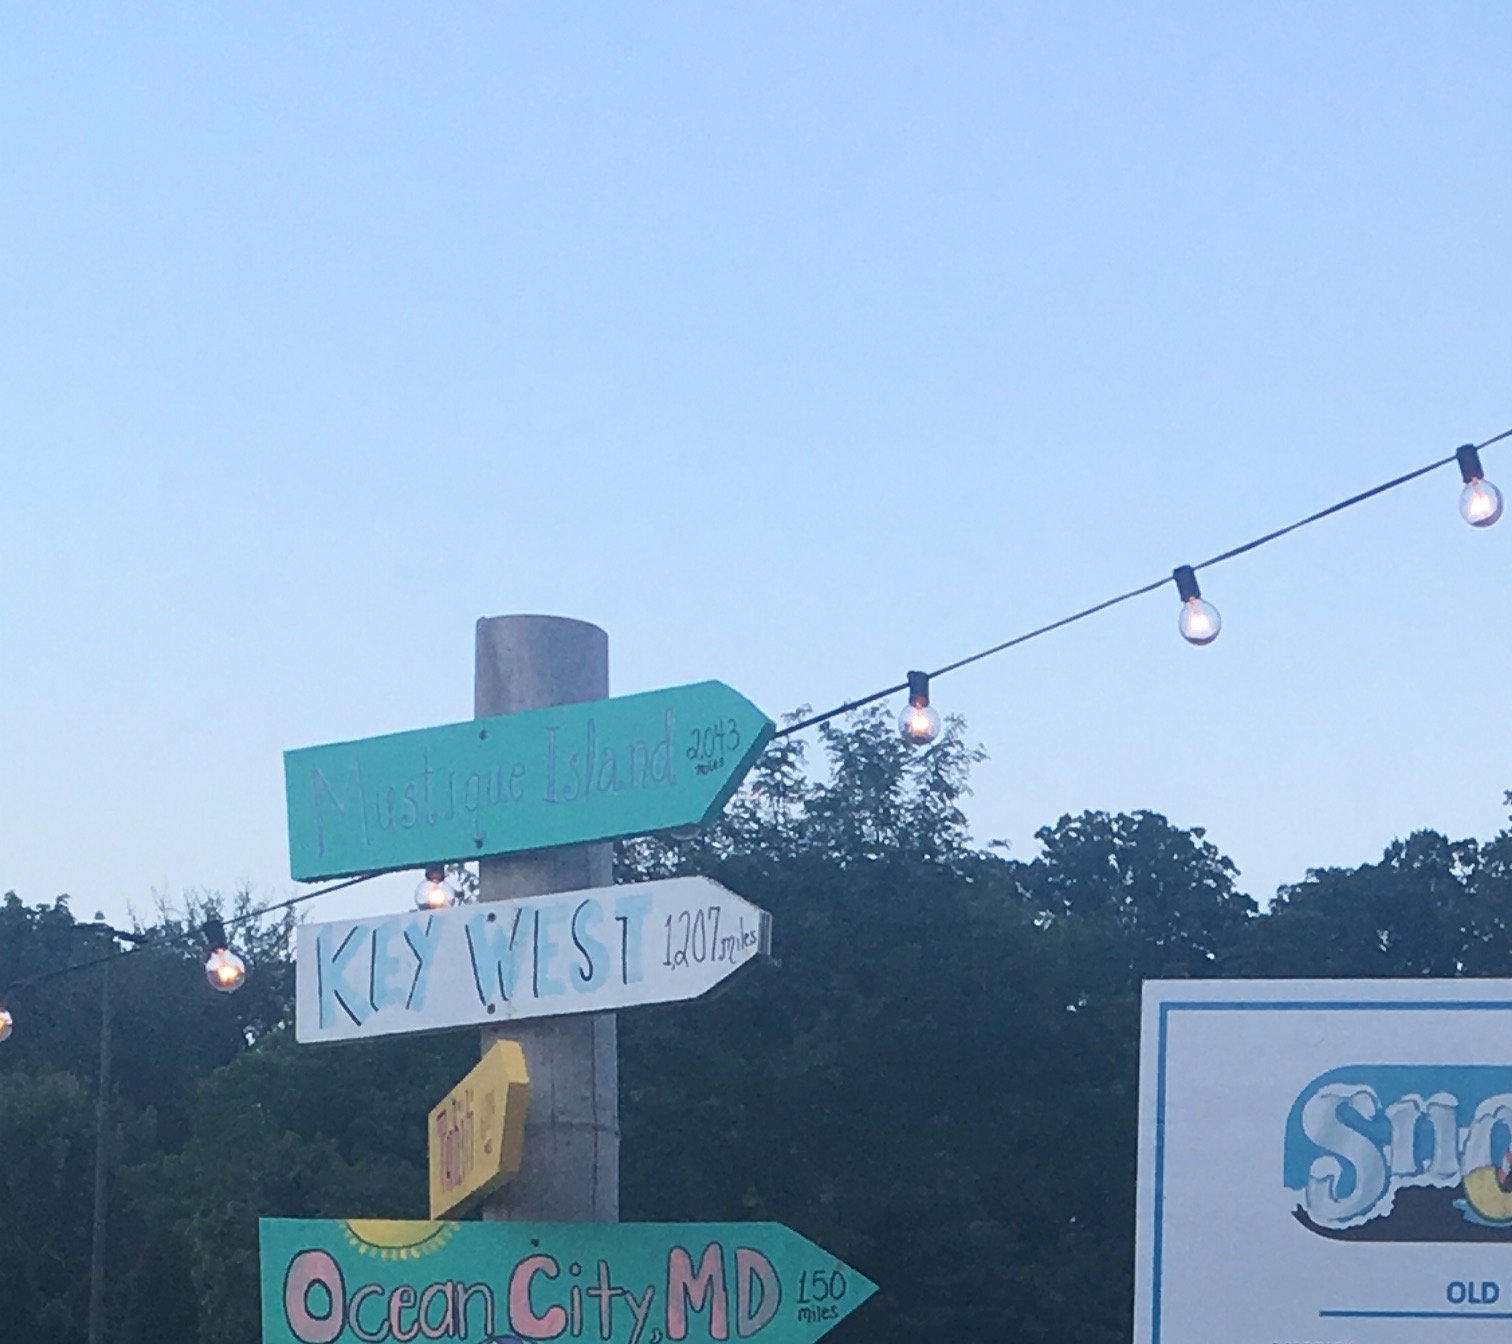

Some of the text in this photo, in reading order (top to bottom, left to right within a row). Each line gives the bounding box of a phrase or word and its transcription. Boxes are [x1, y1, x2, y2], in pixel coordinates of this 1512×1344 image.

[546, 707, 677, 803] Island
[315, 914, 440, 1029] KEY
[465, 894, 653, 1007] WEST
[721, 918, 757, 966] miles
[282, 1248, 493, 1344] Ocean
[666, 1241, 782, 1342] MD
[798, 1270, 847, 1303] 150
[798, 1304, 840, 1324] miles
[1446, 1280, 1500, 1305] OLD
